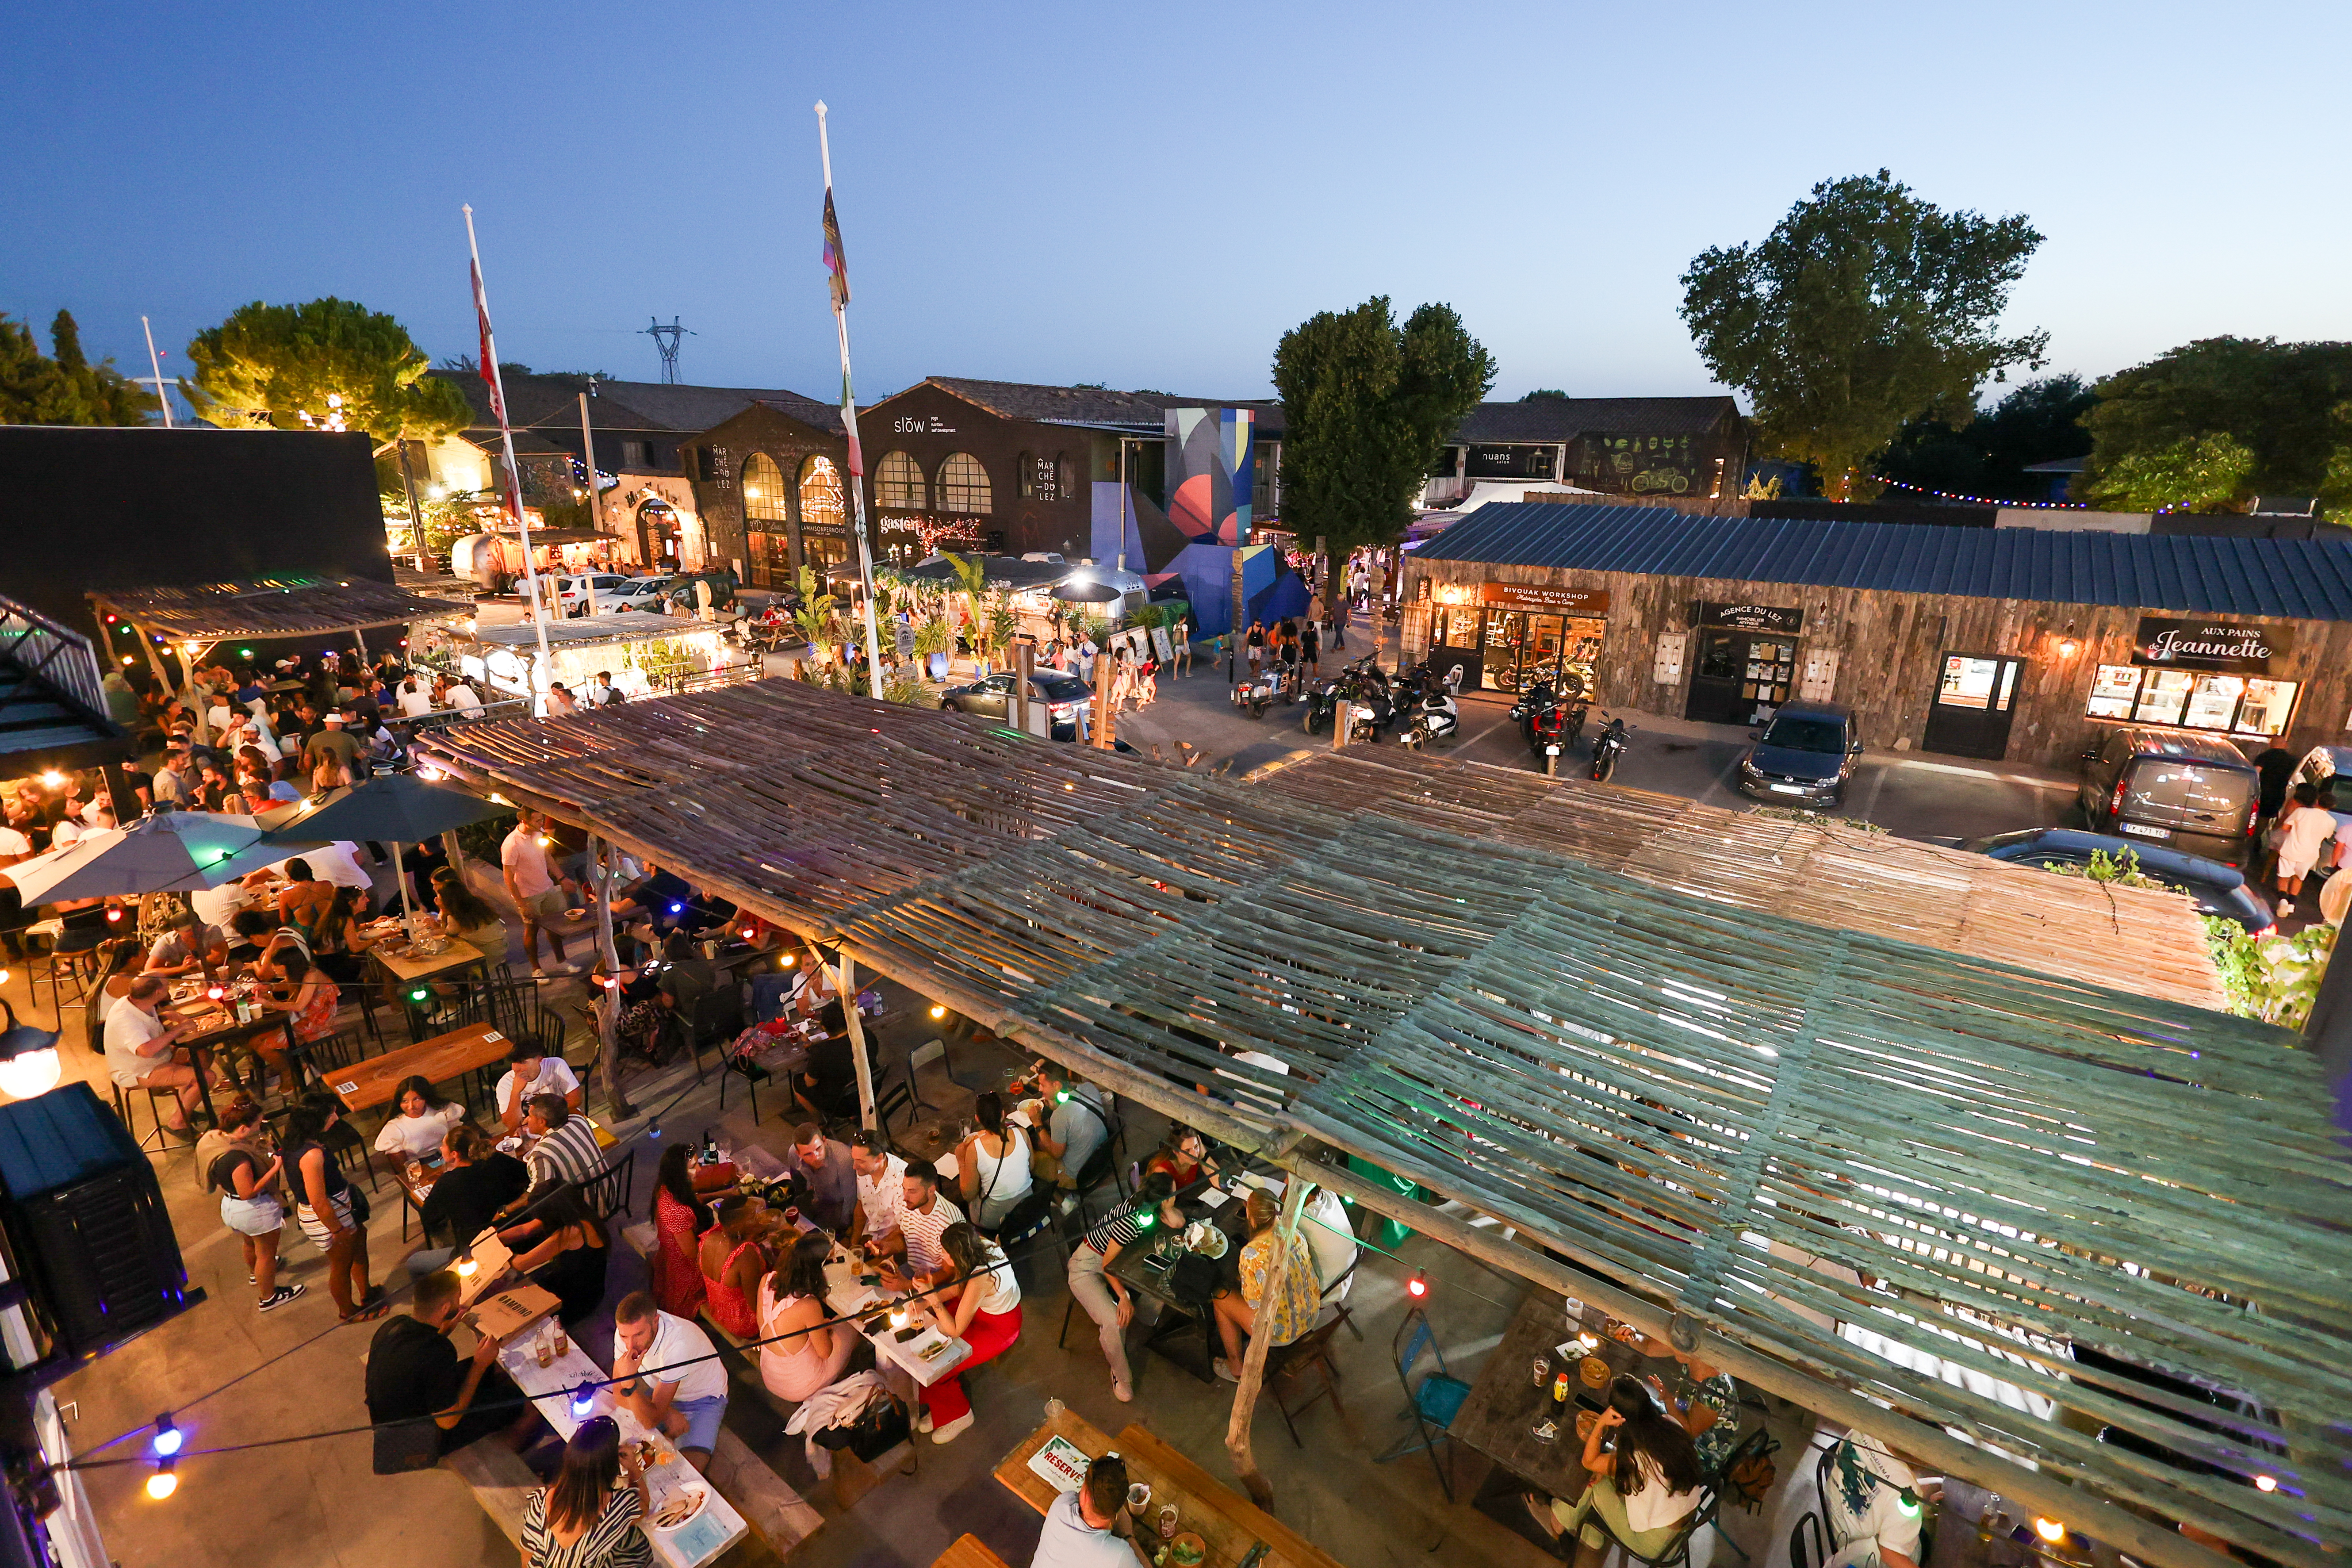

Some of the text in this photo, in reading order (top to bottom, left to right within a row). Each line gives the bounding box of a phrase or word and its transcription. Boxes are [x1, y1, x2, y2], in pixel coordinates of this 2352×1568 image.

[717, 480, 730, 488] LEZ
[1039, 493, 1054, 501] LEZ
[1504, 587, 1589, 600] BIVOUAK WORKSHOP
[1516, 594, 1543, 603] Motorcycles
[1720, 606, 1752, 618] AGENCE
[1768, 611, 1782, 623] LEZ
[2201, 627, 2261, 638] AUX PAINS
[2153, 629, 2273, 660] Jeannette
[1044, 1451, 1084, 1483] RÉSERVÉ
